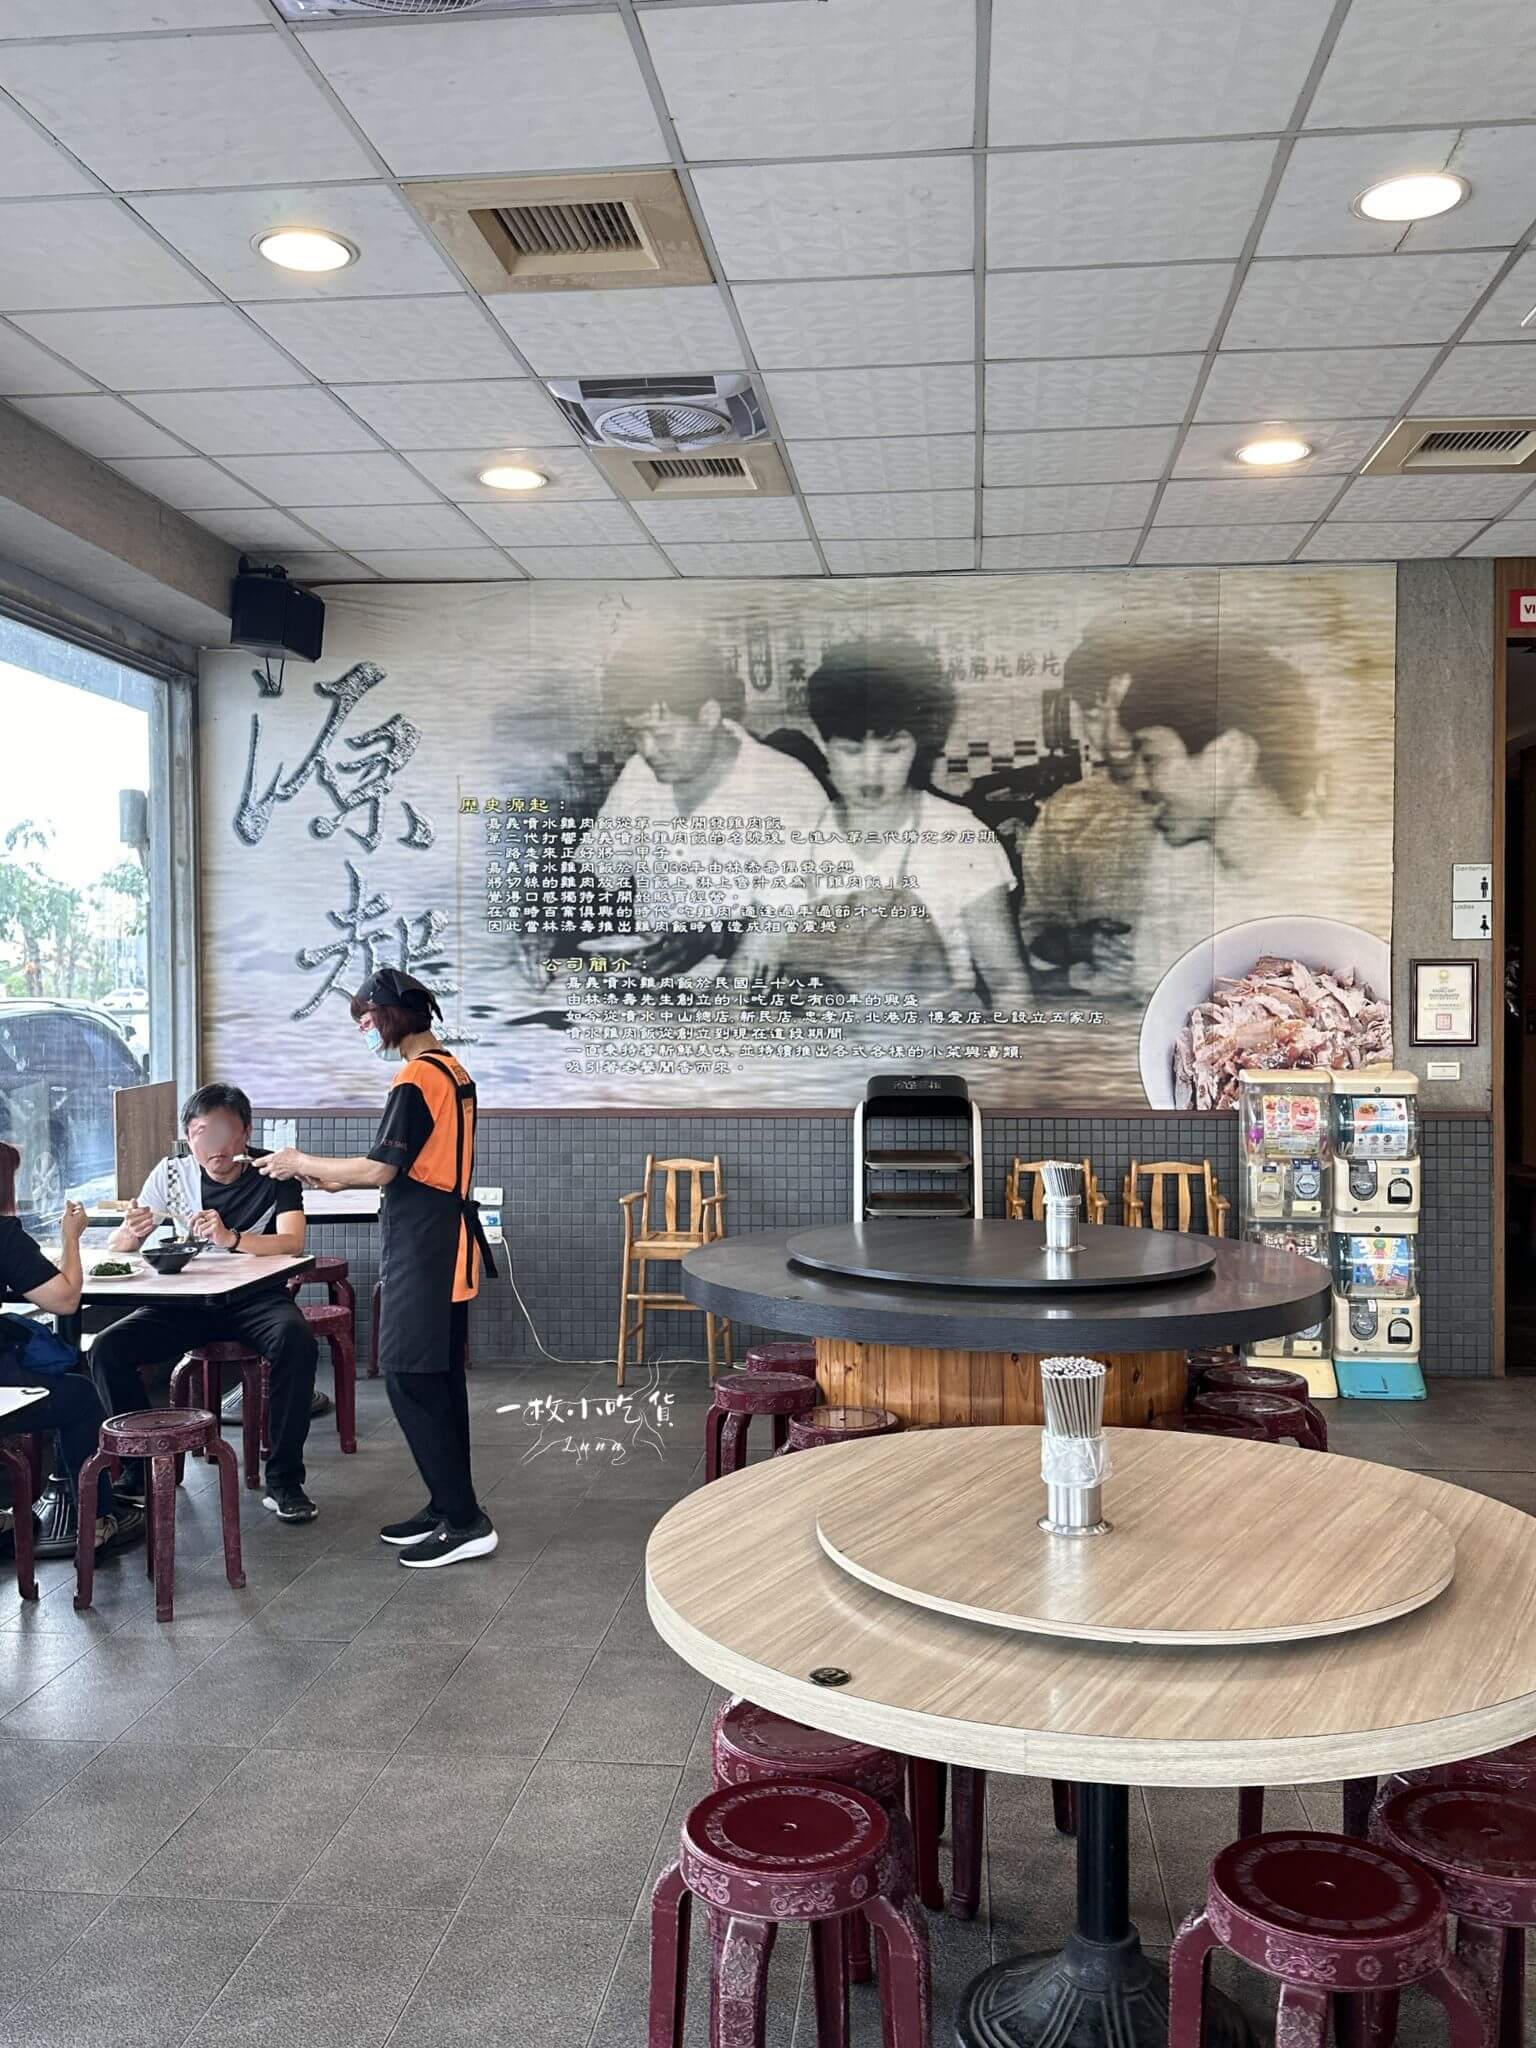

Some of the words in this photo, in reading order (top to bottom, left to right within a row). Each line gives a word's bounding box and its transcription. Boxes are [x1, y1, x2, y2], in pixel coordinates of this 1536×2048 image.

[459, 797, 567, 814] 歷史源起：
[542, 956, 648, 973] 公司簡介：
[565, 976, 825, 990] 嘉義噴水雞肉飯於民國三十八年
